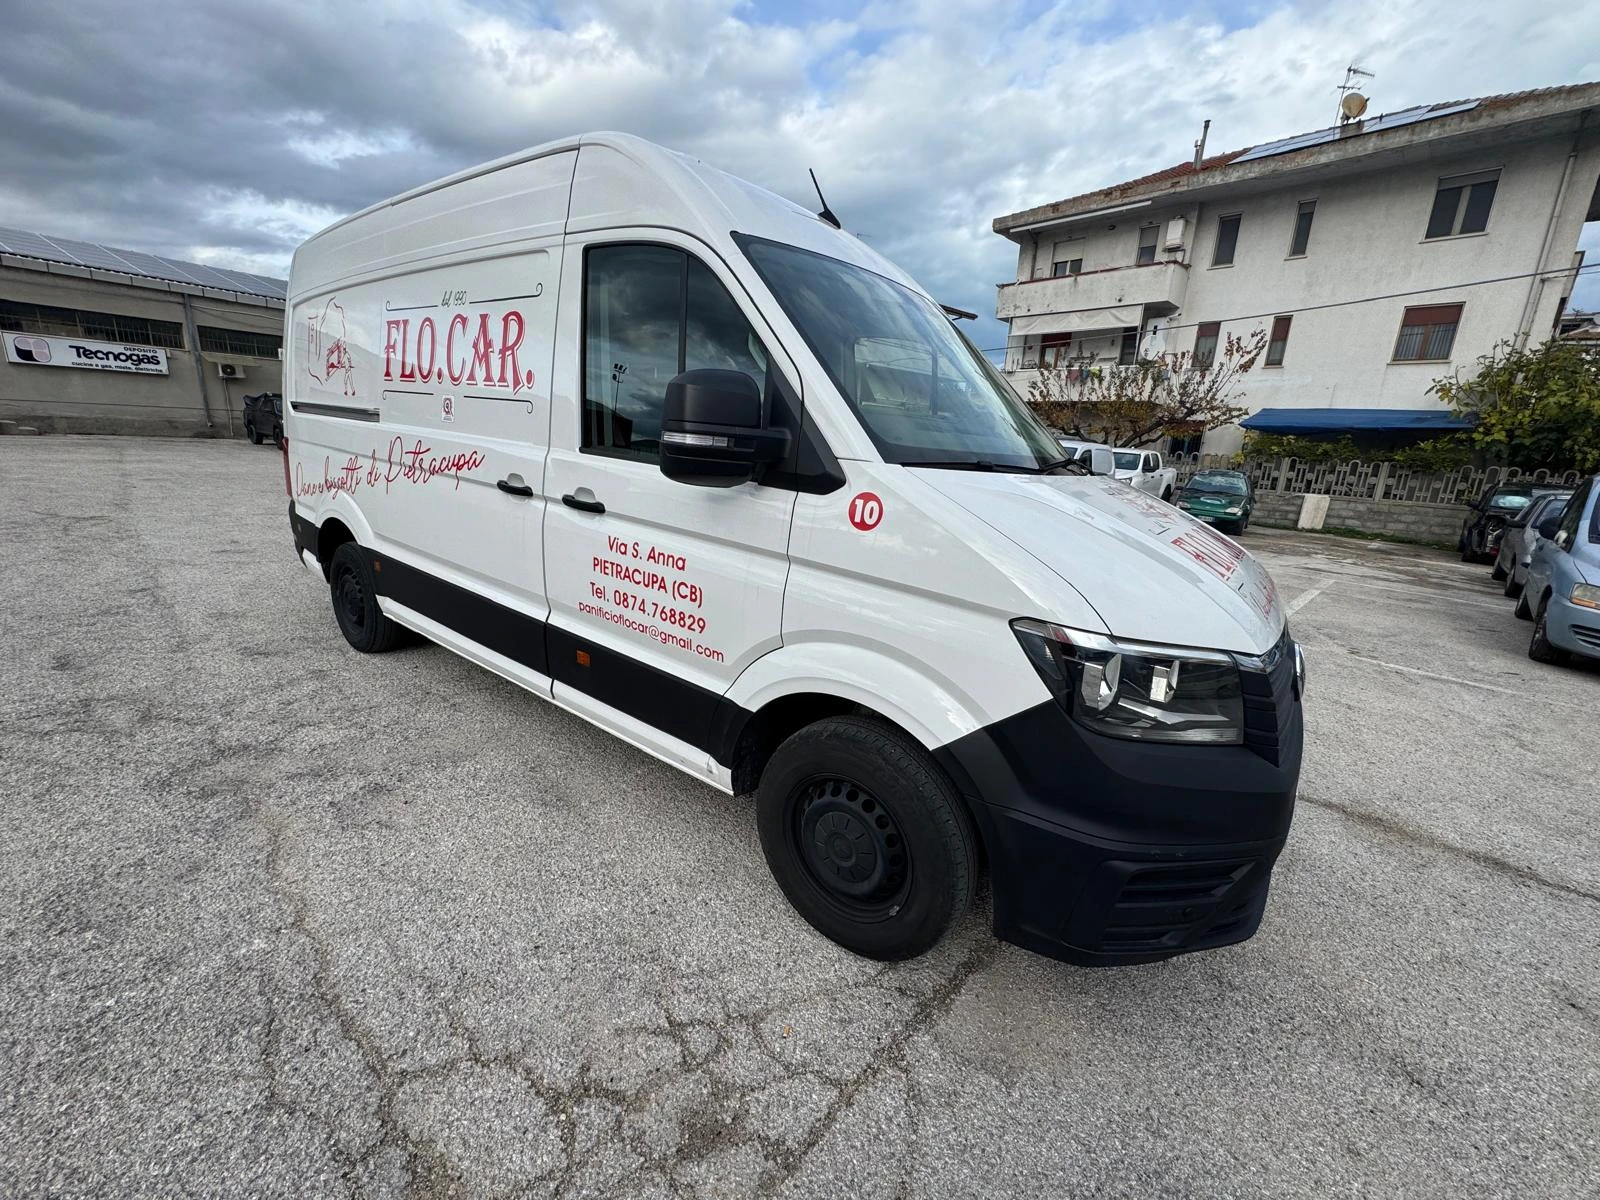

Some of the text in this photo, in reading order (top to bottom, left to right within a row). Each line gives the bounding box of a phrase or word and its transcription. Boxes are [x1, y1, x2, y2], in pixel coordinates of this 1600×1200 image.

[69, 345, 160, 366] Tecnogas
[384, 311, 534, 395] FLO.CAR.
[367, 449, 381, 487] di
[854, 498, 878, 525] 10
[608, 535, 686, 571] Via S. Anna
[593, 557, 703, 608] PIETRACUPA (CB)
[590, 582, 706, 634] Tel. 0874.768829
[579, 602, 724, 663] panificioflocar@gmail.com
